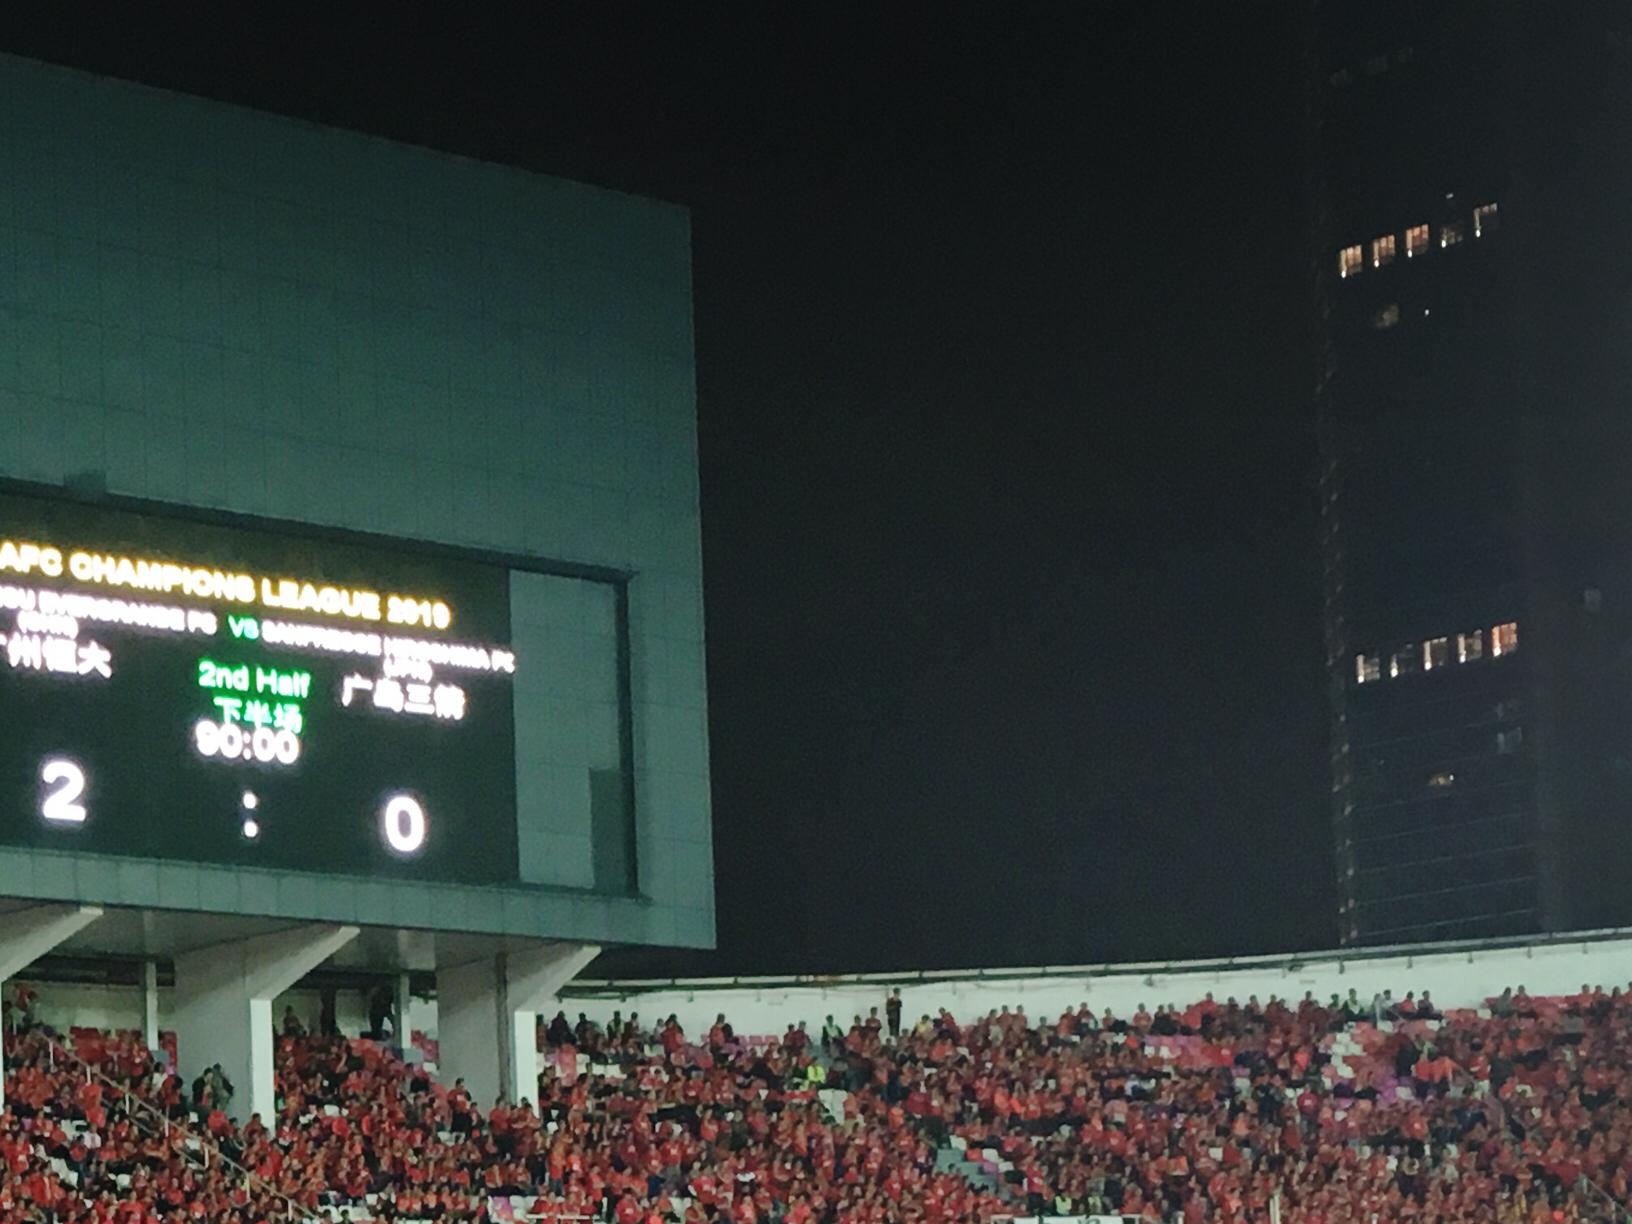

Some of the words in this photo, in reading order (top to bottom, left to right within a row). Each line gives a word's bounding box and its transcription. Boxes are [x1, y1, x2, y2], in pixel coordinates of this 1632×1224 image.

[69, 552, 256, 602] CHAMPIONS
[261, 577, 382, 620] LEAGUE
[198, 658, 250, 690] 2nd
[256, 666, 312, 699] Half
[195, 719, 299, 764] 90:00
[41, 760, 87, 823] 2
[383, 795, 427, 853] 0
